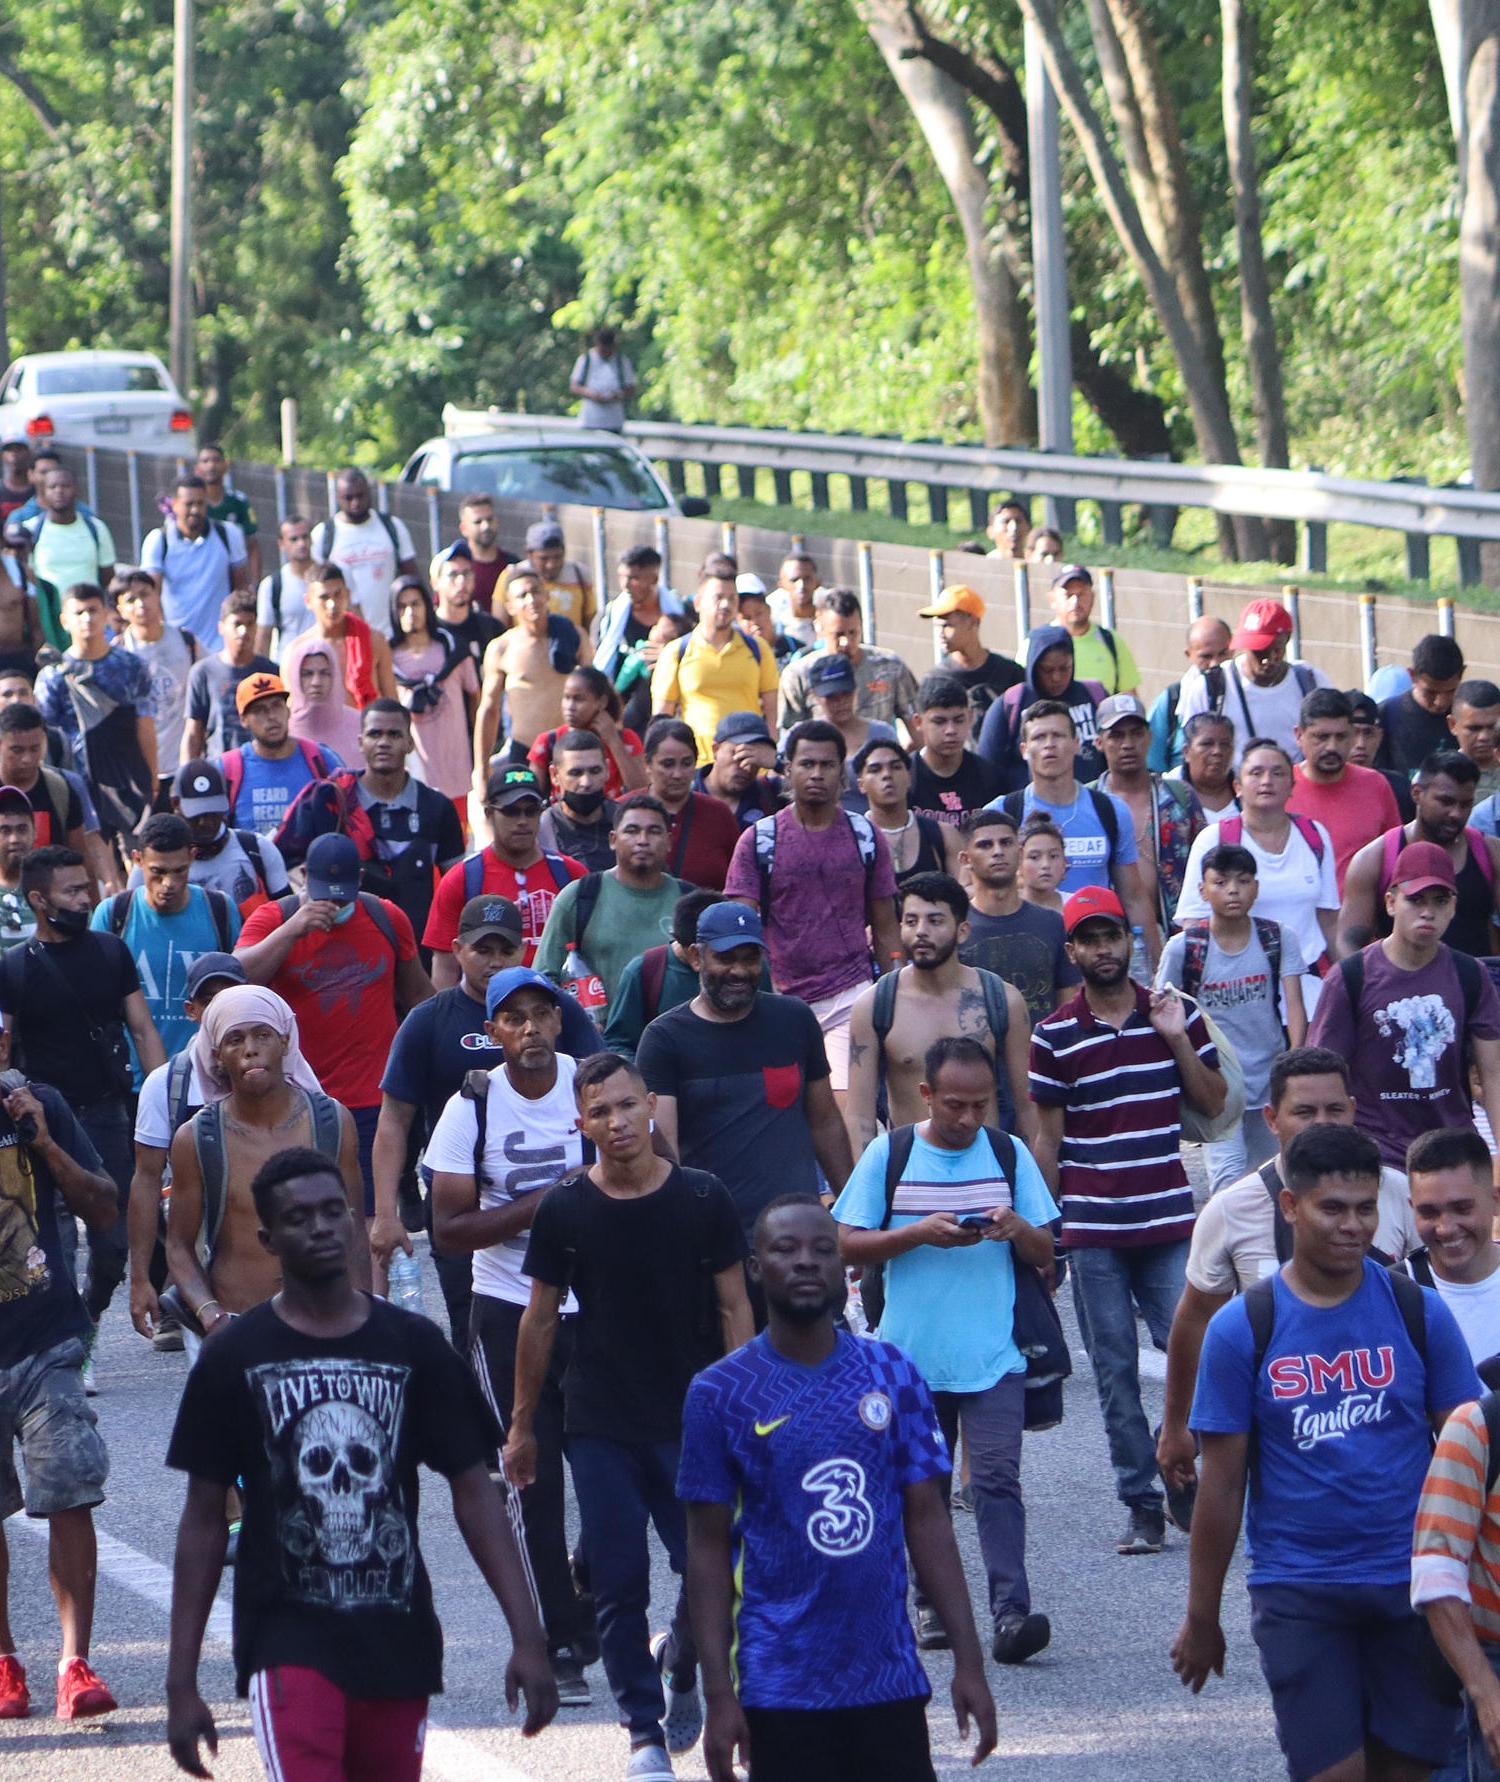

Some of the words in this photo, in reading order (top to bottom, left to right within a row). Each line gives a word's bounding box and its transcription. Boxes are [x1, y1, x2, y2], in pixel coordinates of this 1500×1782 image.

[252, 786, 288, 803] HEARD
[1380, 1092, 1419, 1100] SLEATER
[1268, 1346, 1395, 1400] SMU
[262, 1374, 322, 1436] LIVE
[322, 1374, 351, 1399] TO
[352, 1374, 400, 1436] WIN
[1291, 1390, 1391, 1450] Ignited
[801, 1458, 874, 1556] 3
